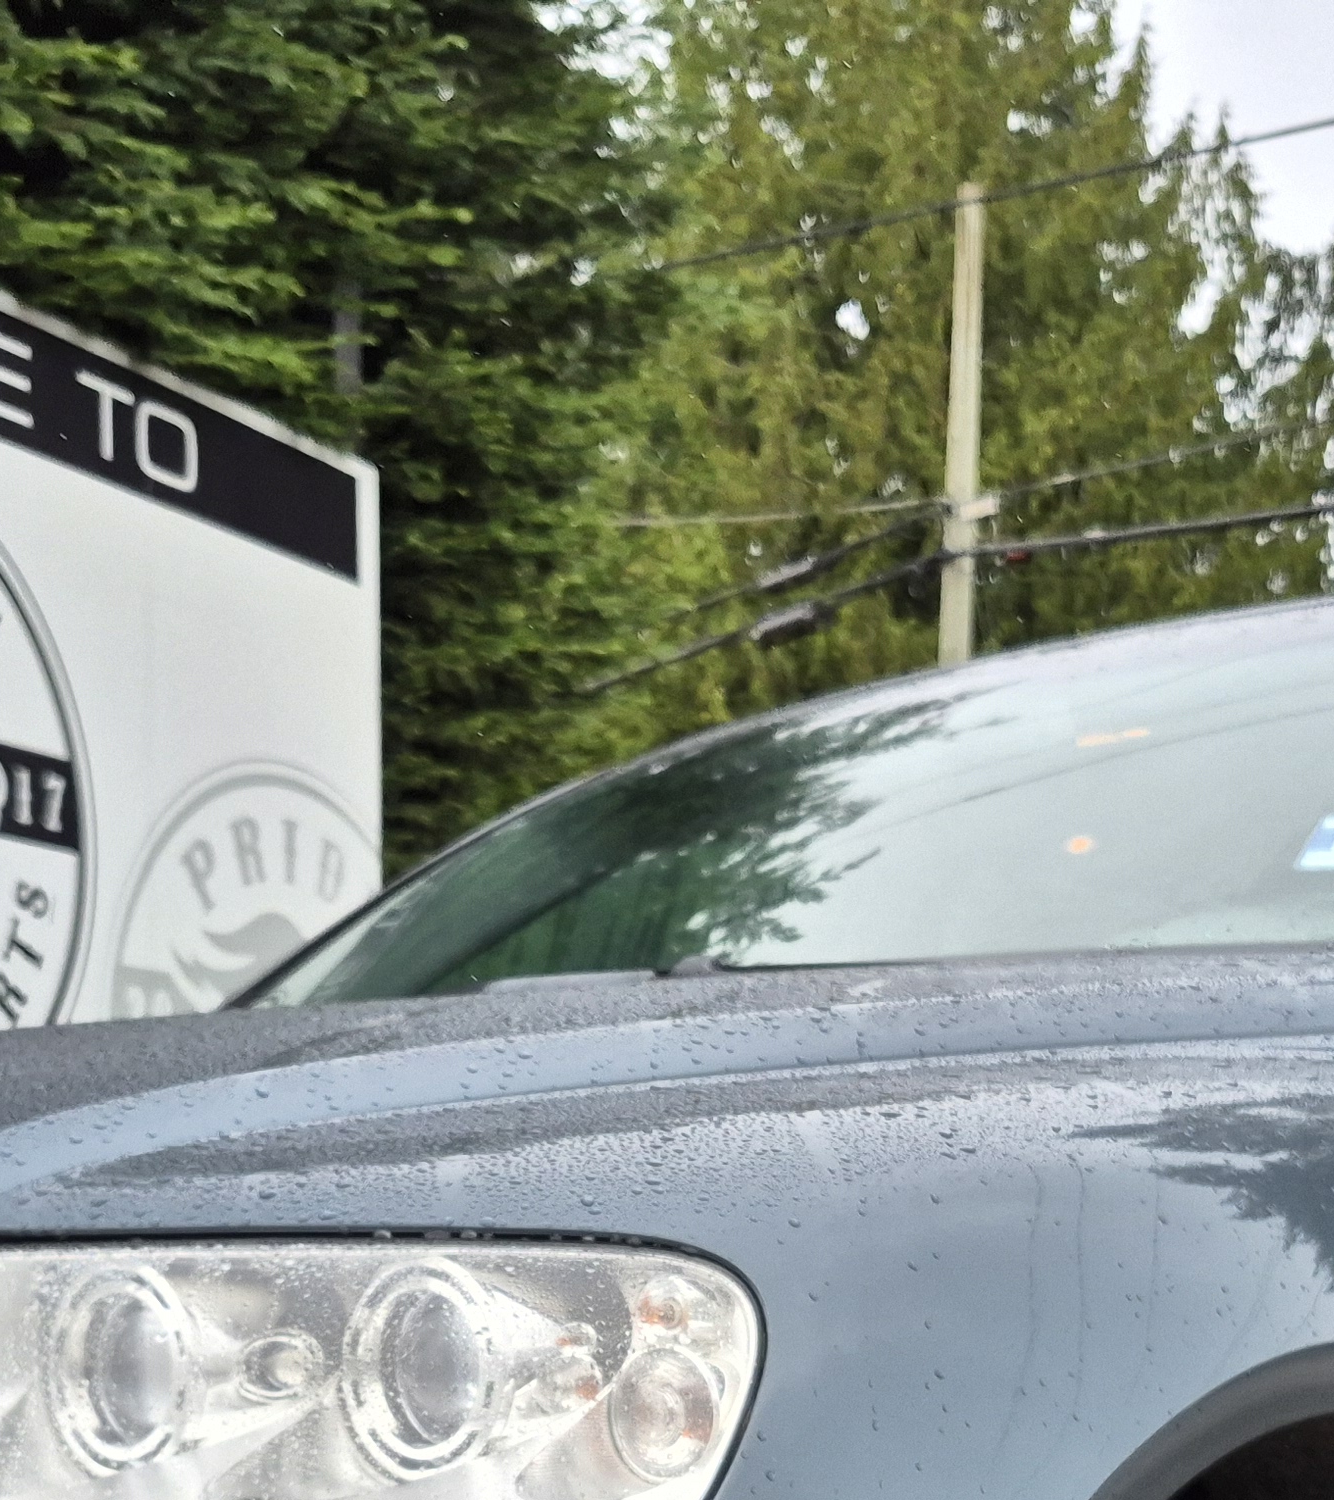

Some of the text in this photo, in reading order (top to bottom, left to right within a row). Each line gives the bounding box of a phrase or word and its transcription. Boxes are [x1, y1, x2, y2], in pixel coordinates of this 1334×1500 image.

[78, 371, 197, 495] TO
[11, 766, 64, 834] 17
[180, 815, 345, 913] PRID
